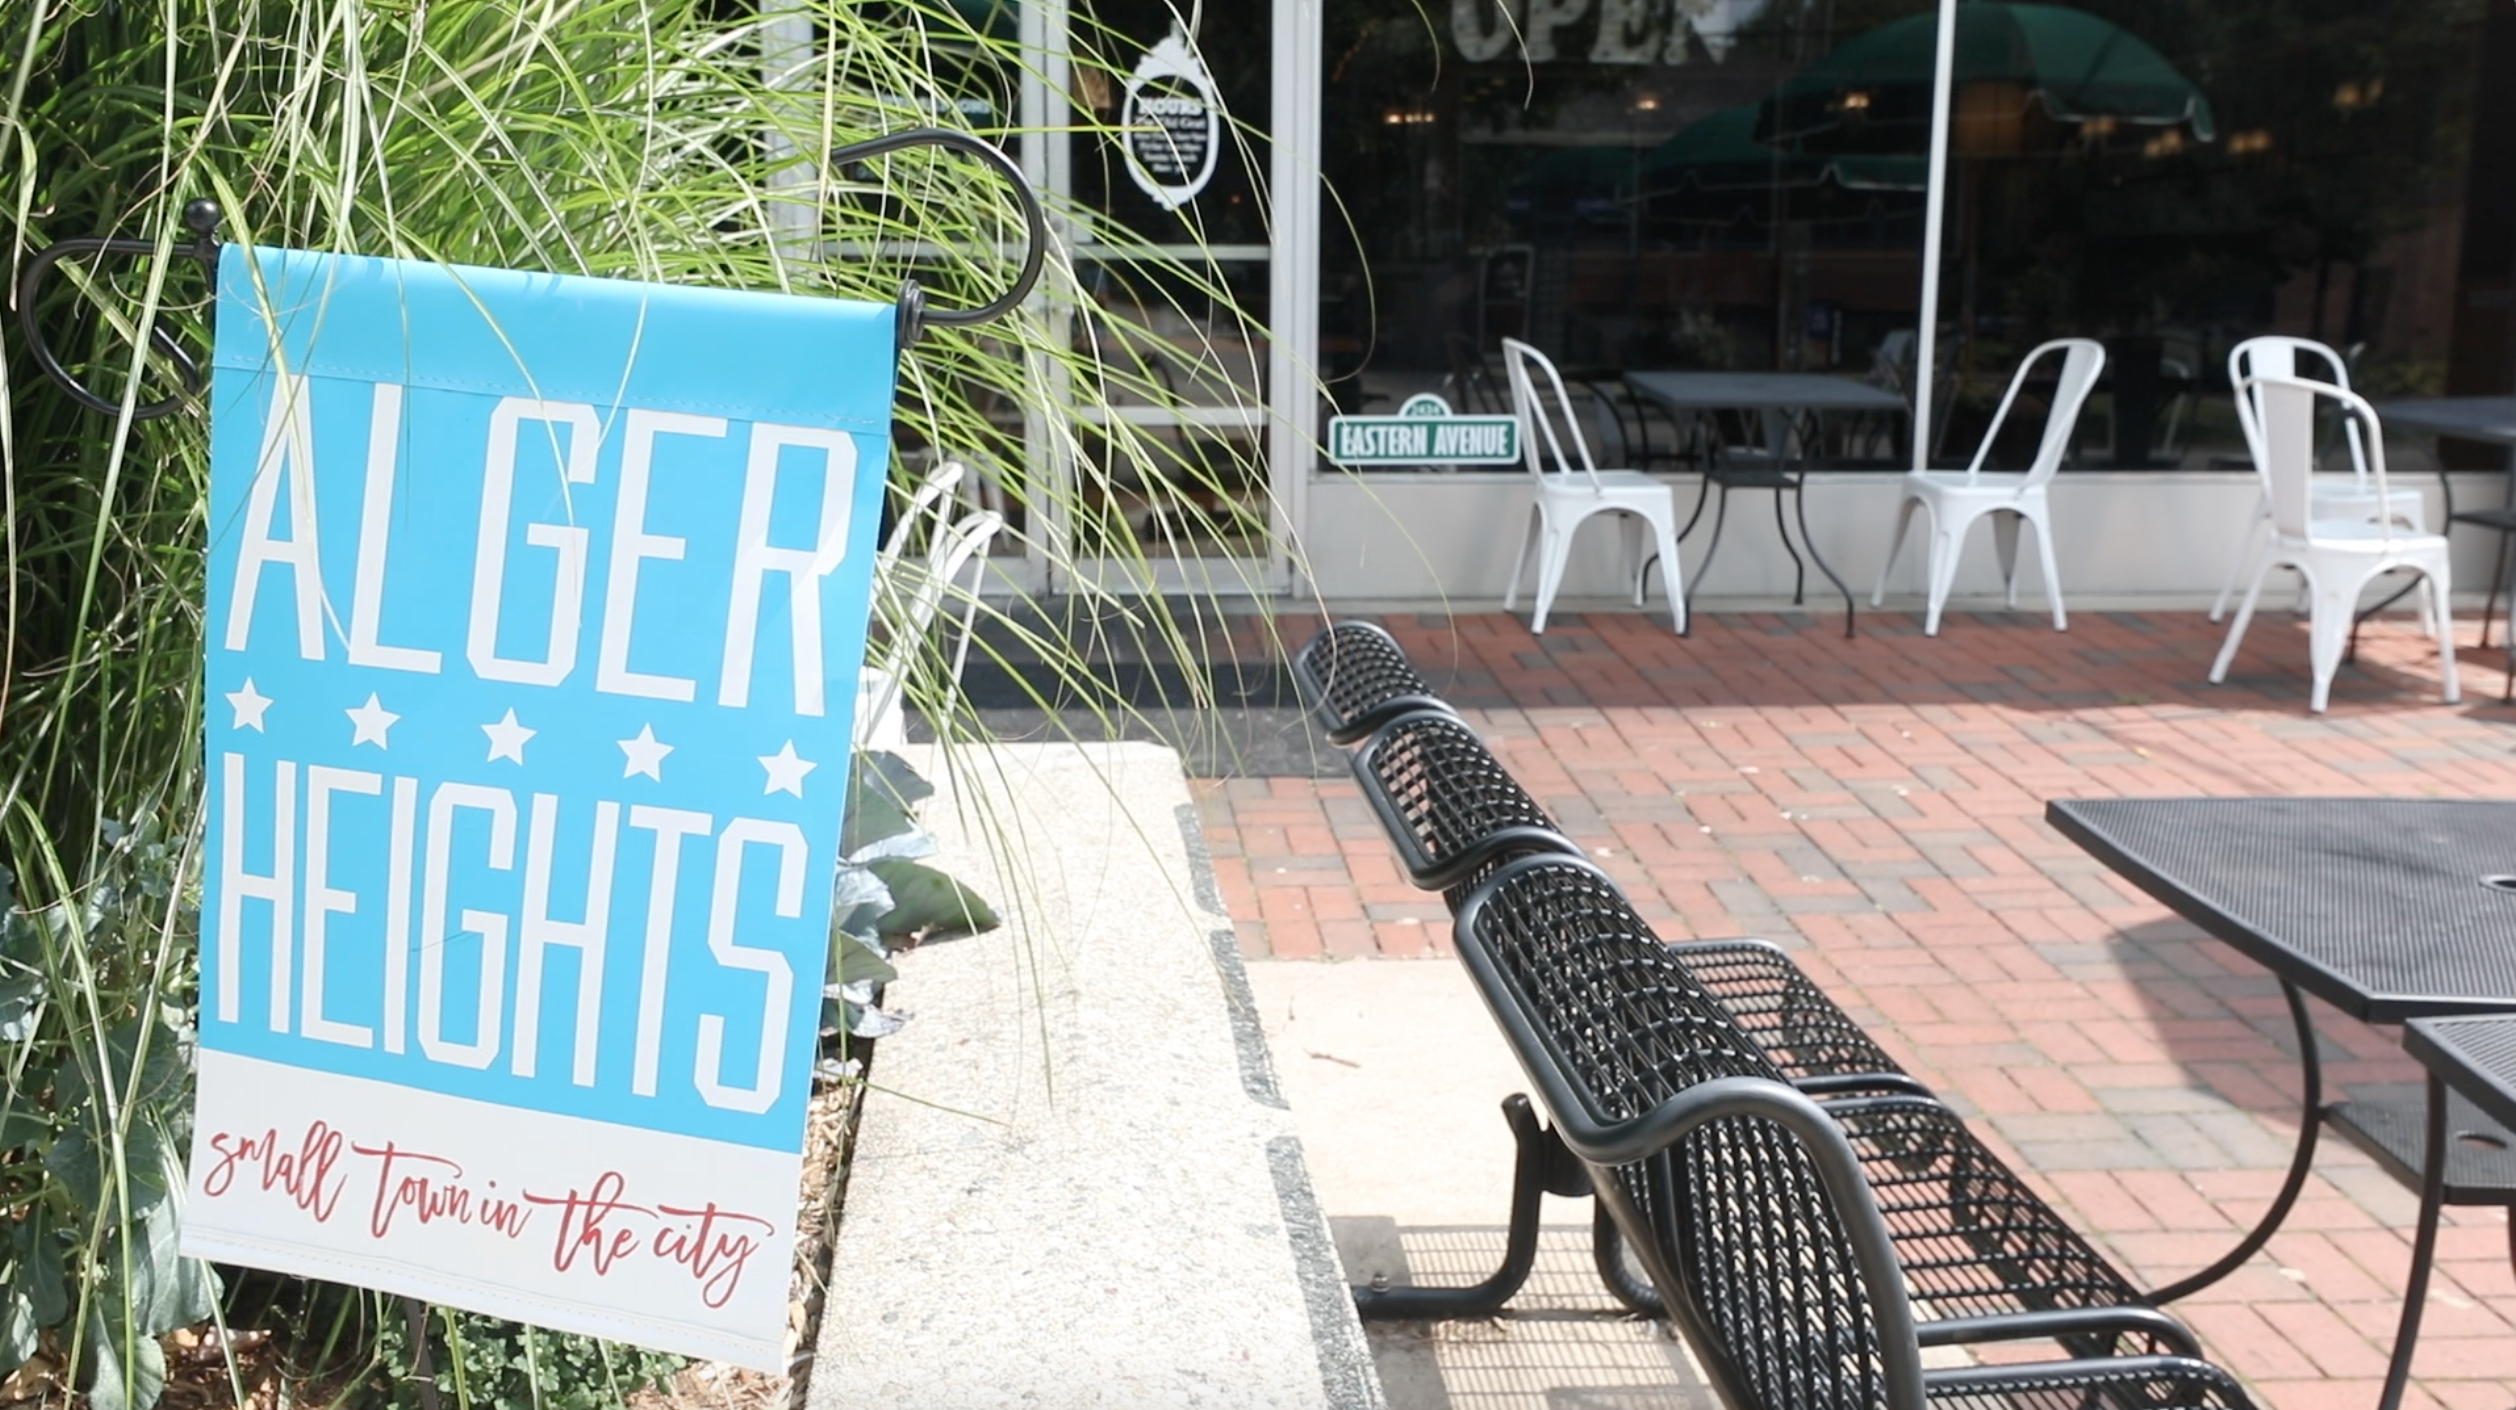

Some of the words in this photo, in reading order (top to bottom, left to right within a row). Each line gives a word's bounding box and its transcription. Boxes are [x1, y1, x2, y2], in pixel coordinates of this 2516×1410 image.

[1451, 0, 1735, 65] OPEN
[1341, 424, 1428, 457] EASTERN
[1433, 424, 1509, 456] AVENUE
[225, 375, 857, 717] ALGER
[218, 752, 808, 1115] HEIGHTS
[203, 1120, 348, 1222] small
[480, 1180, 533, 1238] in
[522, 1171, 661, 1275] the
[652, 1202, 775, 1308] city
